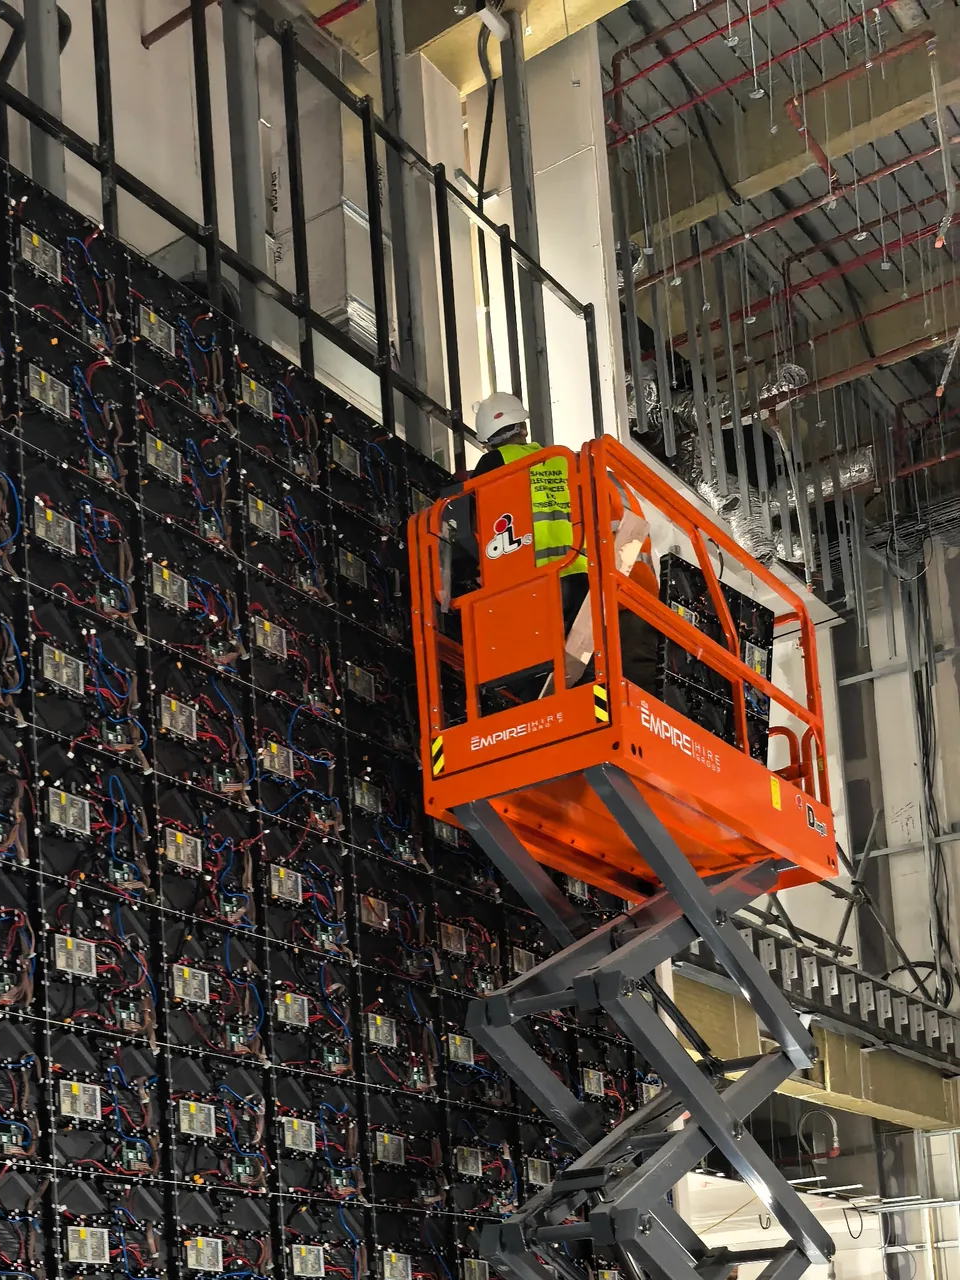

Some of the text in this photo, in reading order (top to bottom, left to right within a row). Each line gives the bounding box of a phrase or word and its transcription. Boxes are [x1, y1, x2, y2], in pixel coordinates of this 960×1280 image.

[470, 712, 563, 751] EMPIRE HIRE
[532, 718, 564, 732] GROP
[641, 706, 721, 767] EMPIRE HIRE
